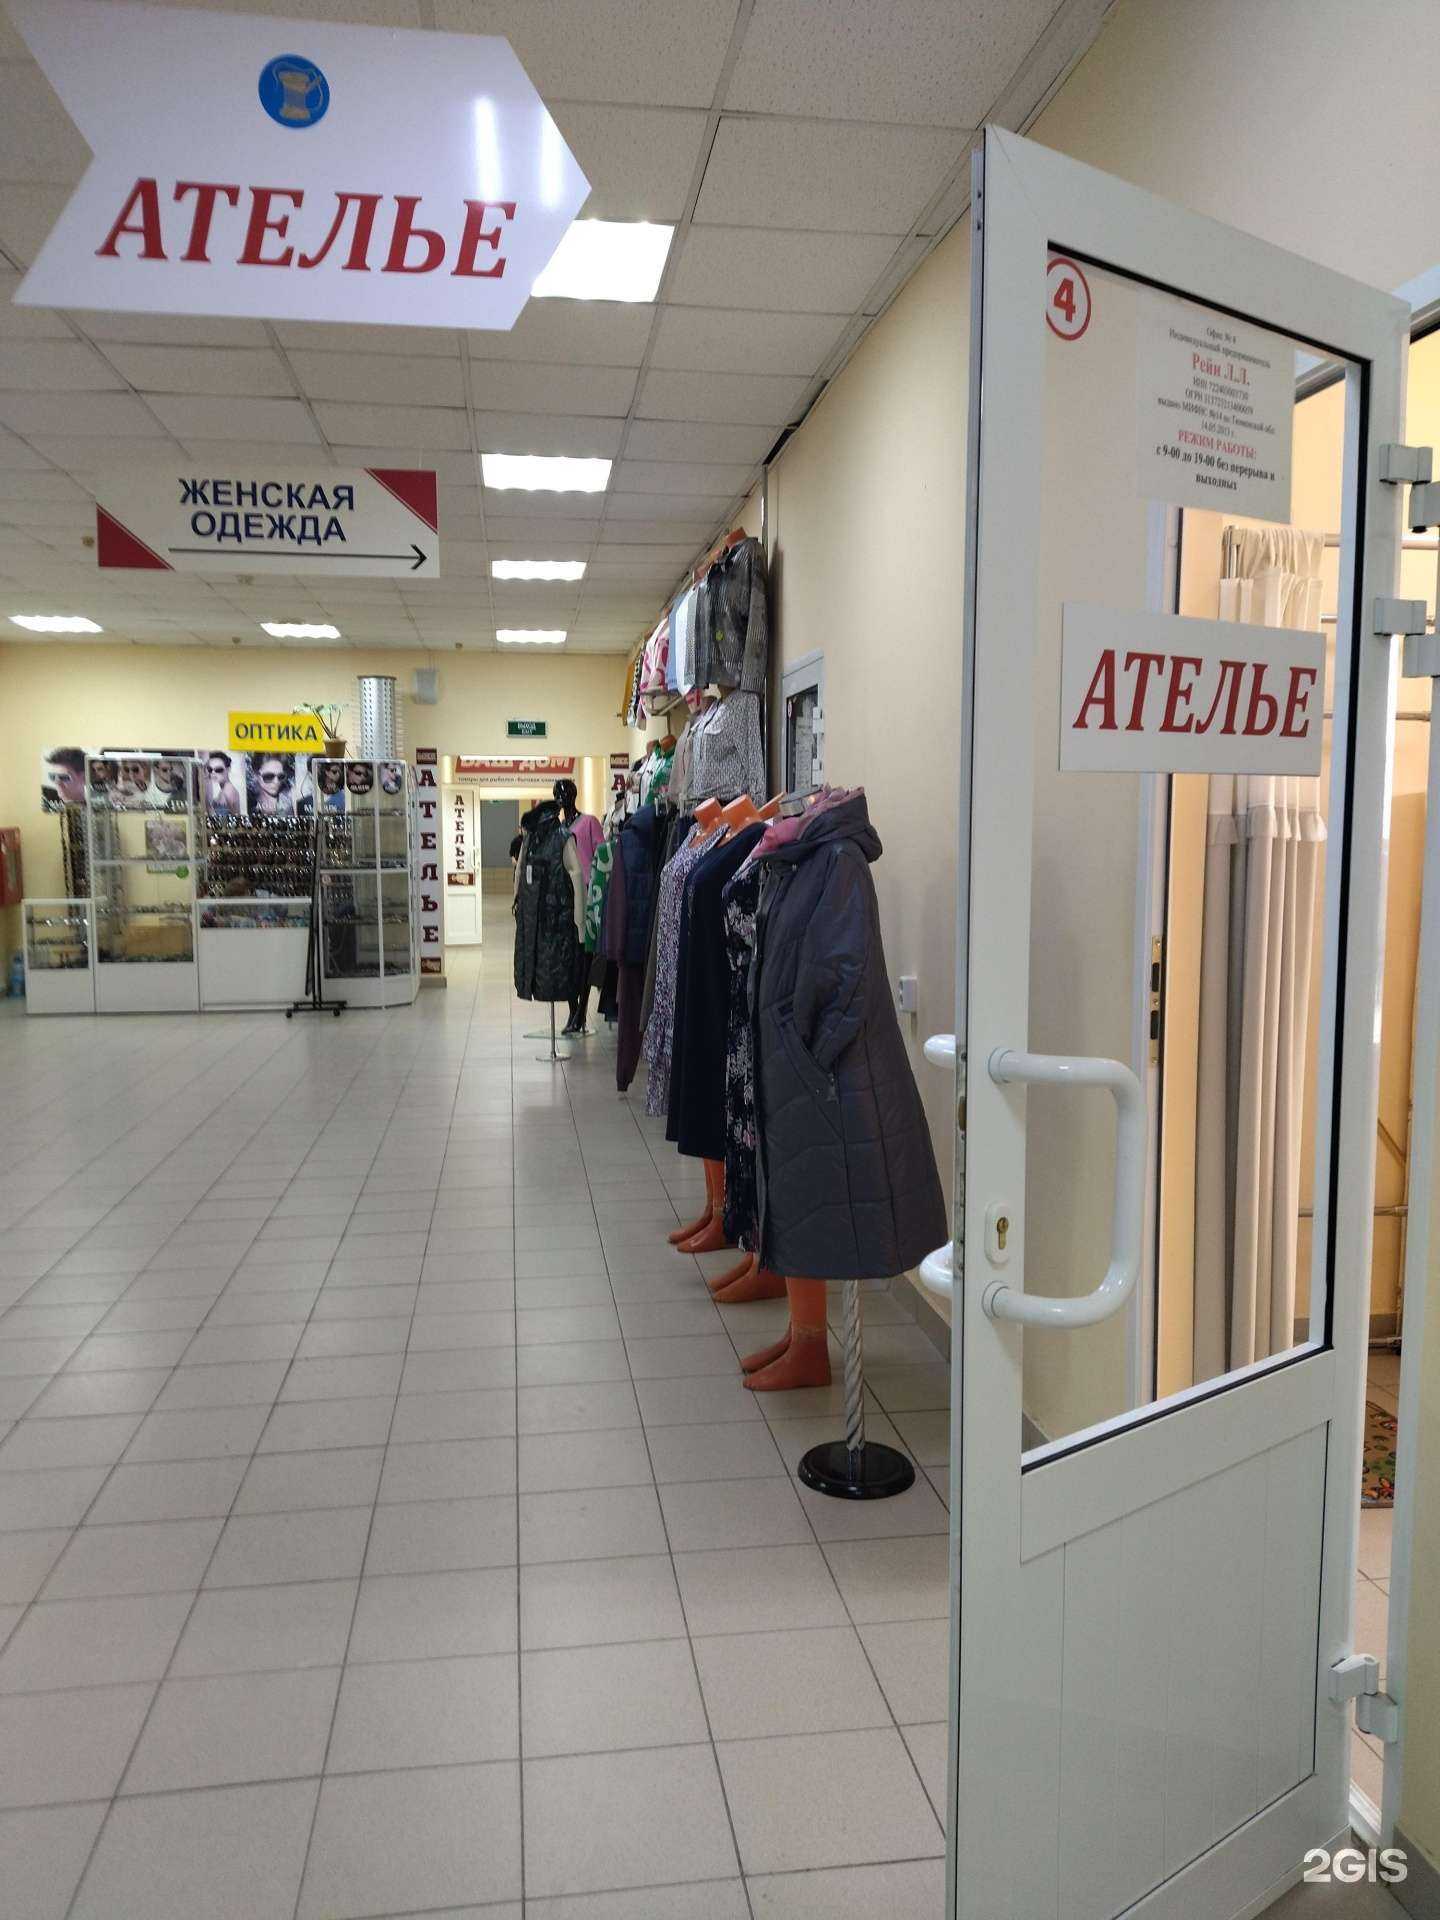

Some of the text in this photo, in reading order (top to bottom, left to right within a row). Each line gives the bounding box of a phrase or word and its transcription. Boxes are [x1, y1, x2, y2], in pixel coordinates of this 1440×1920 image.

[94, 177, 516, 279] АТЕЛЬЕ
[1053, 277, 1076, 323] 4
[1192, 353, 1221, 377] Рейн
[1162, 444, 1180, 460] 9-00
[1194, 453, 1215, 467] 19-00
[1216, 457, 1229, 472] без
[1230, 463, 1268, 480] перерыва
[1177, 429, 1258, 460] РЕЖИМ РАБОТЫ:
[179, 478, 355, 511] ЖЕНСКАЯ
[1195, 472, 1238, 491] выходных
[190, 510, 347, 544] ОДЕЖДА
[1072, 648, 1318, 738] АТЕЛЬЕ
[235, 722, 318, 742] ОПТИКА
[454, 794, 465, 870] АТЕЛЬЕ
[418, 769, 439, 943] АТЕЛЬЕ
